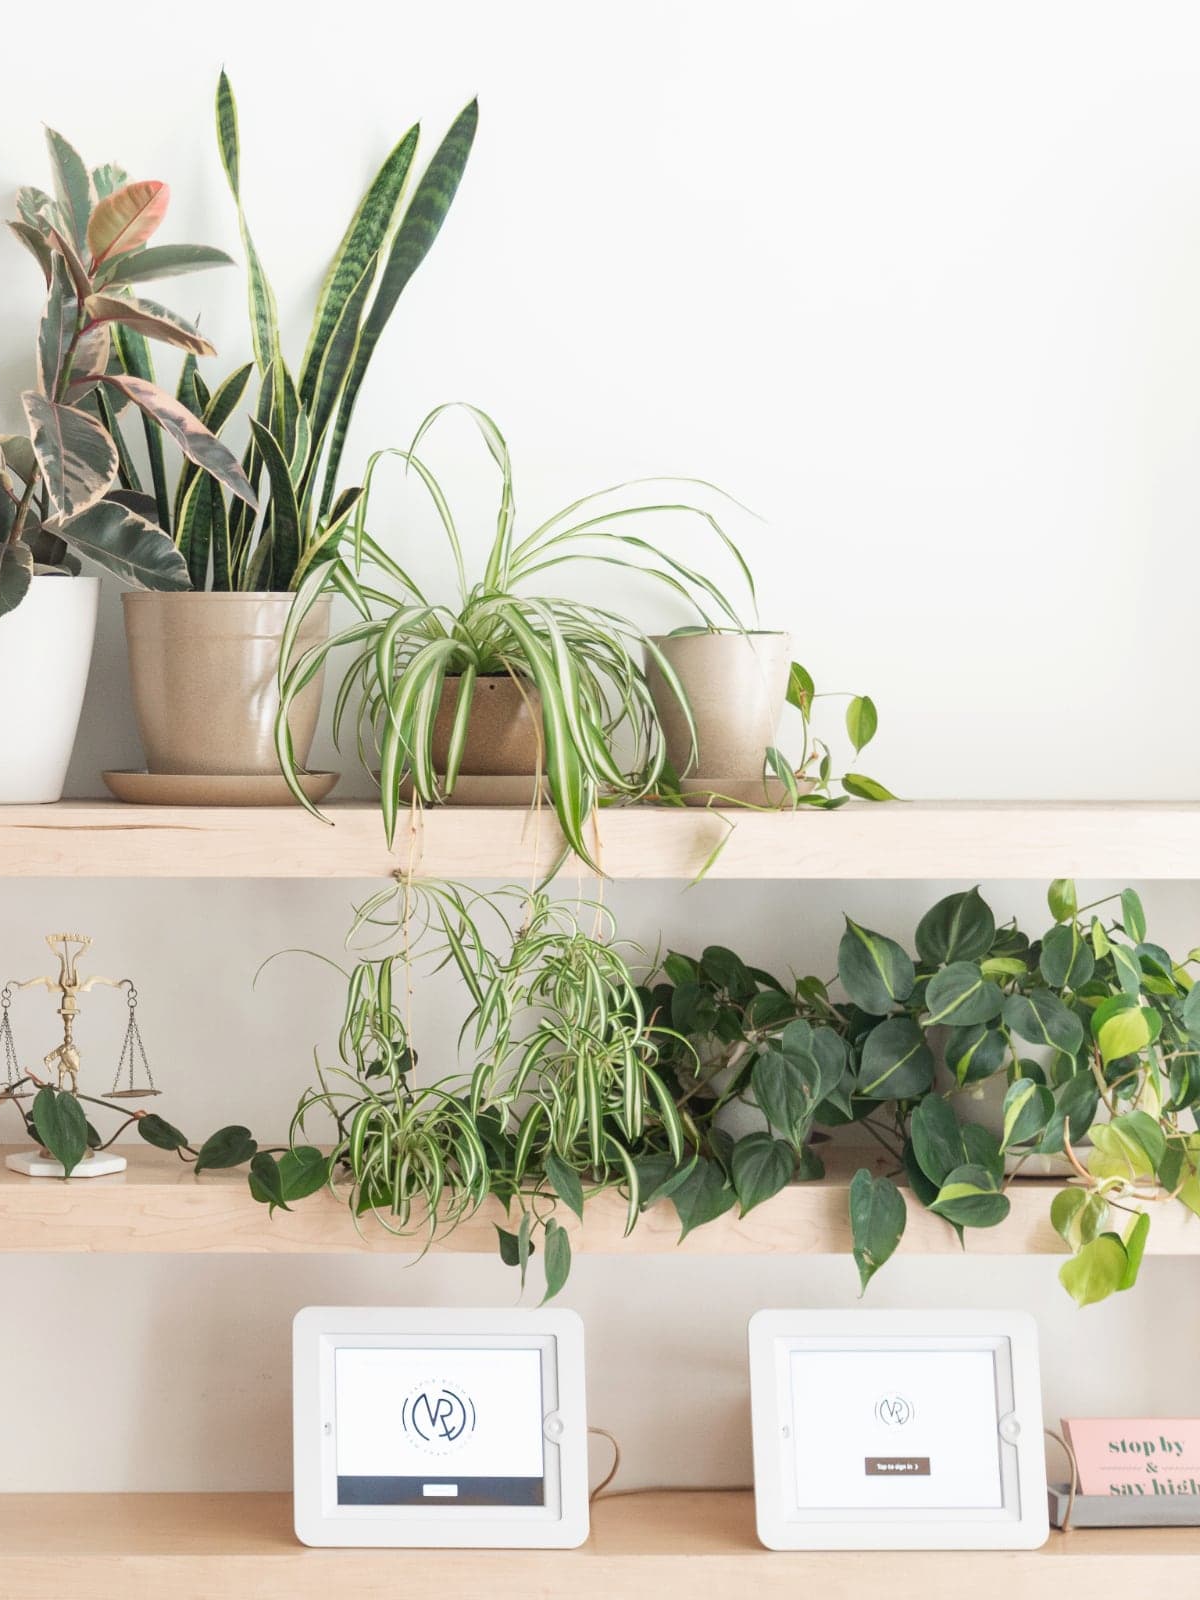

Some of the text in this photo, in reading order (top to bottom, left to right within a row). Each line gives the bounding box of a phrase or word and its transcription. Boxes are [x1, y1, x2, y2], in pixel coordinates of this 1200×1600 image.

[1108, 1436, 1184, 1457] stop by
[1146, 1462, 1158, 1473] &
